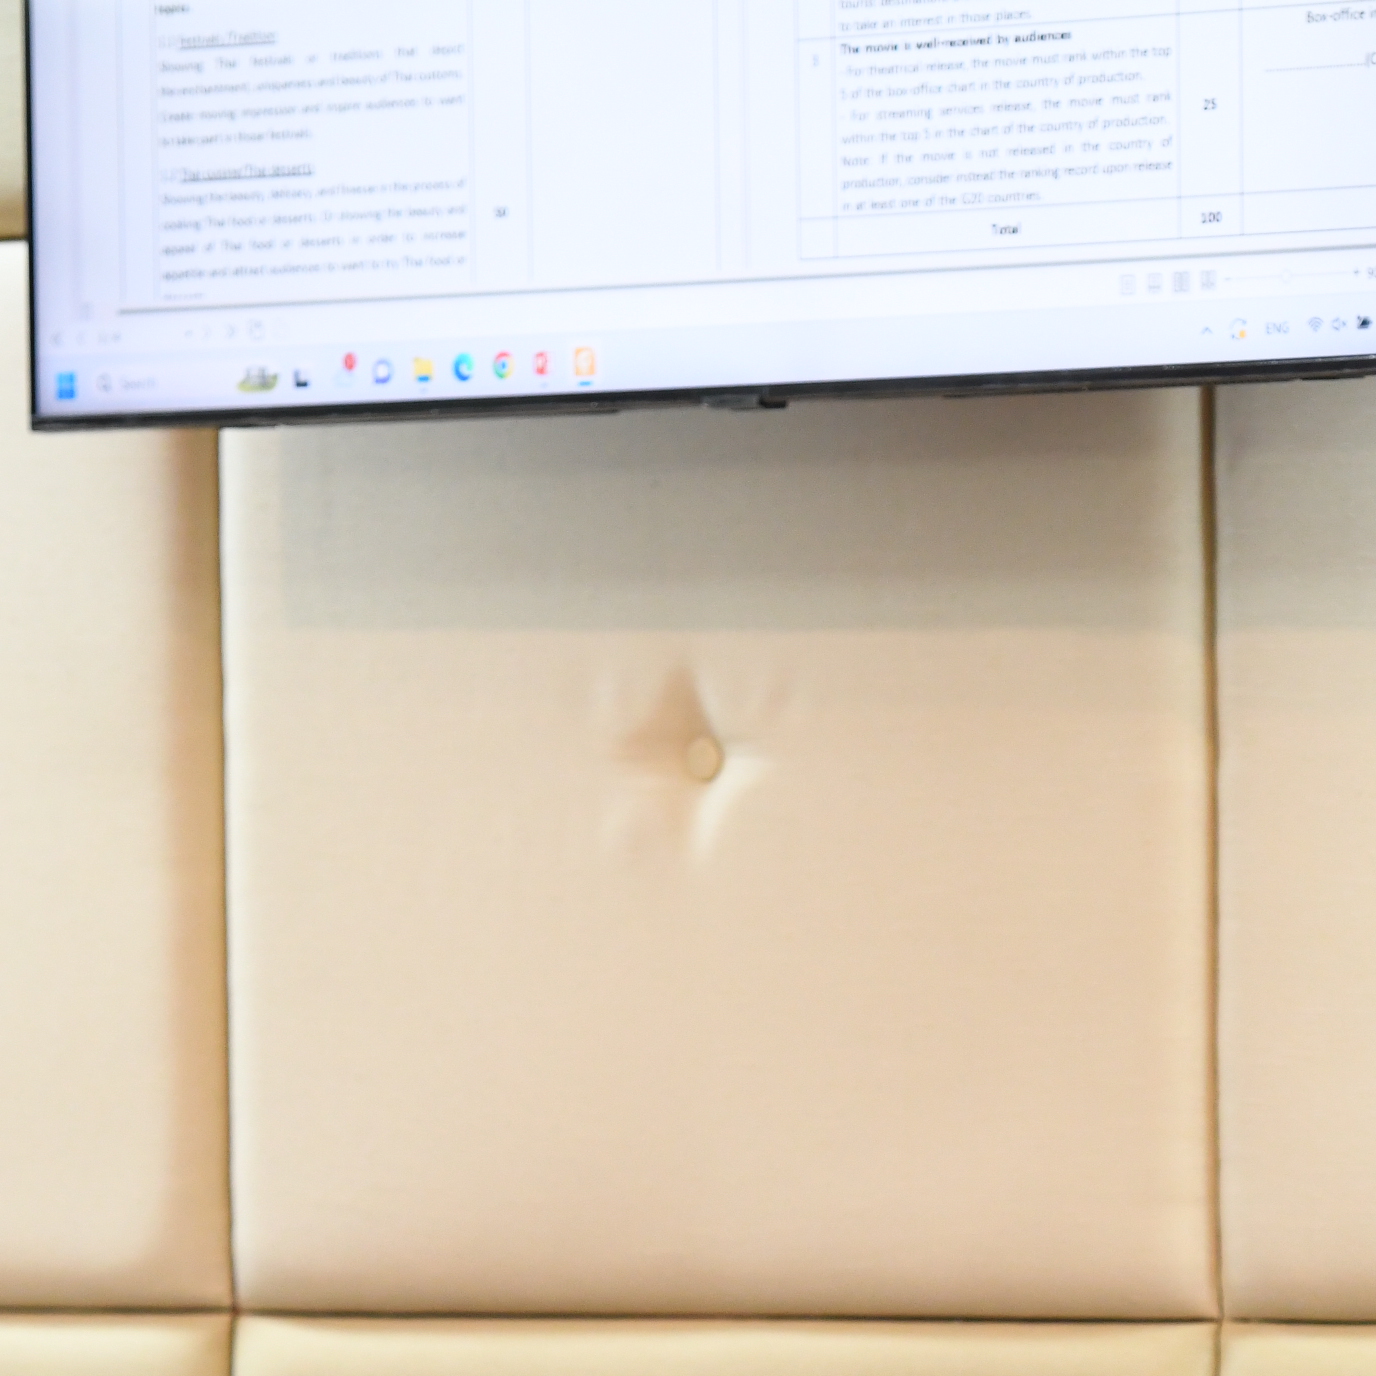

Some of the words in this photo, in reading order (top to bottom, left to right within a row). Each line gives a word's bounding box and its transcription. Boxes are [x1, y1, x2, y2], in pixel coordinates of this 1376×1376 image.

[1306, 8, 1366, 24] Box-office
[840, 42, 859, 54] The
[865, 39, 899, 52] movie
[904, 38, 912, 50] is
[996, 31, 1009, 46] by
[1013, 27, 1072, 42] audiences
[1200, 210, 1223, 225] 100
[991, 221, 1022, 236] Total
[1265, 321, 1290, 335] ENG
